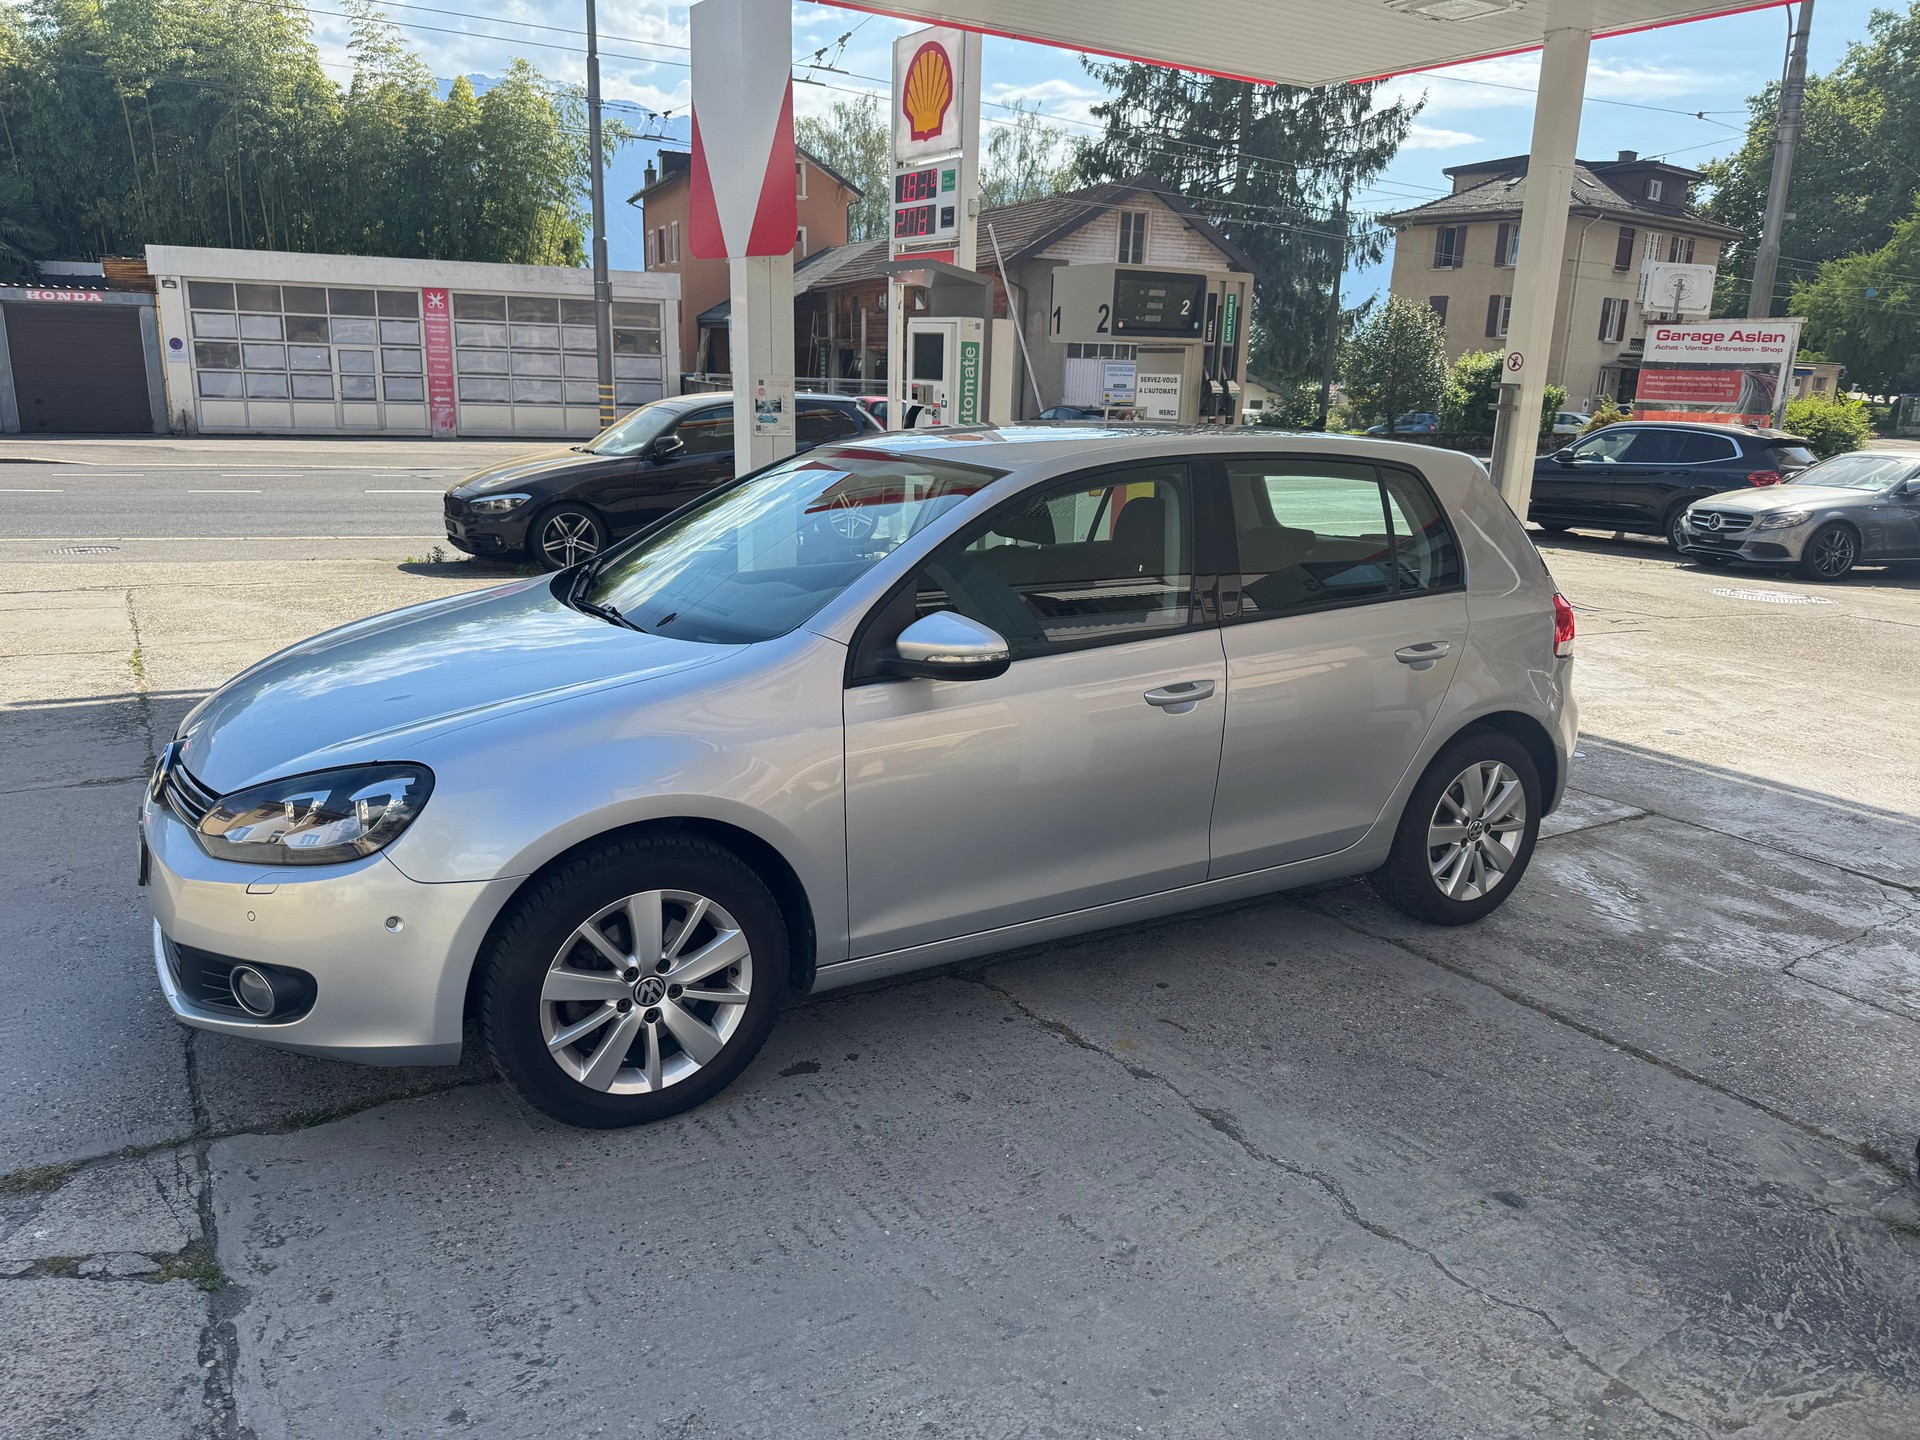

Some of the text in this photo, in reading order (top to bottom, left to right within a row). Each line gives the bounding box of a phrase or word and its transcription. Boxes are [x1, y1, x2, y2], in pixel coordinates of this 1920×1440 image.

[896, 207, 928, 238] 2.08
[26, 291, 103, 302] HONDA
[1180, 300, 1190, 315] 2
[1053, 306, 1061, 334] 1
[1096, 304, 1110, 333] 2
[1656, 329, 1786, 345] Garage Aslan
[1761, 346, 1784, 354] Shop
[1140, 376, 1178, 384] SERVEZ-VOUS
[1144, 387, 1178, 395] L'AUTOMATE
